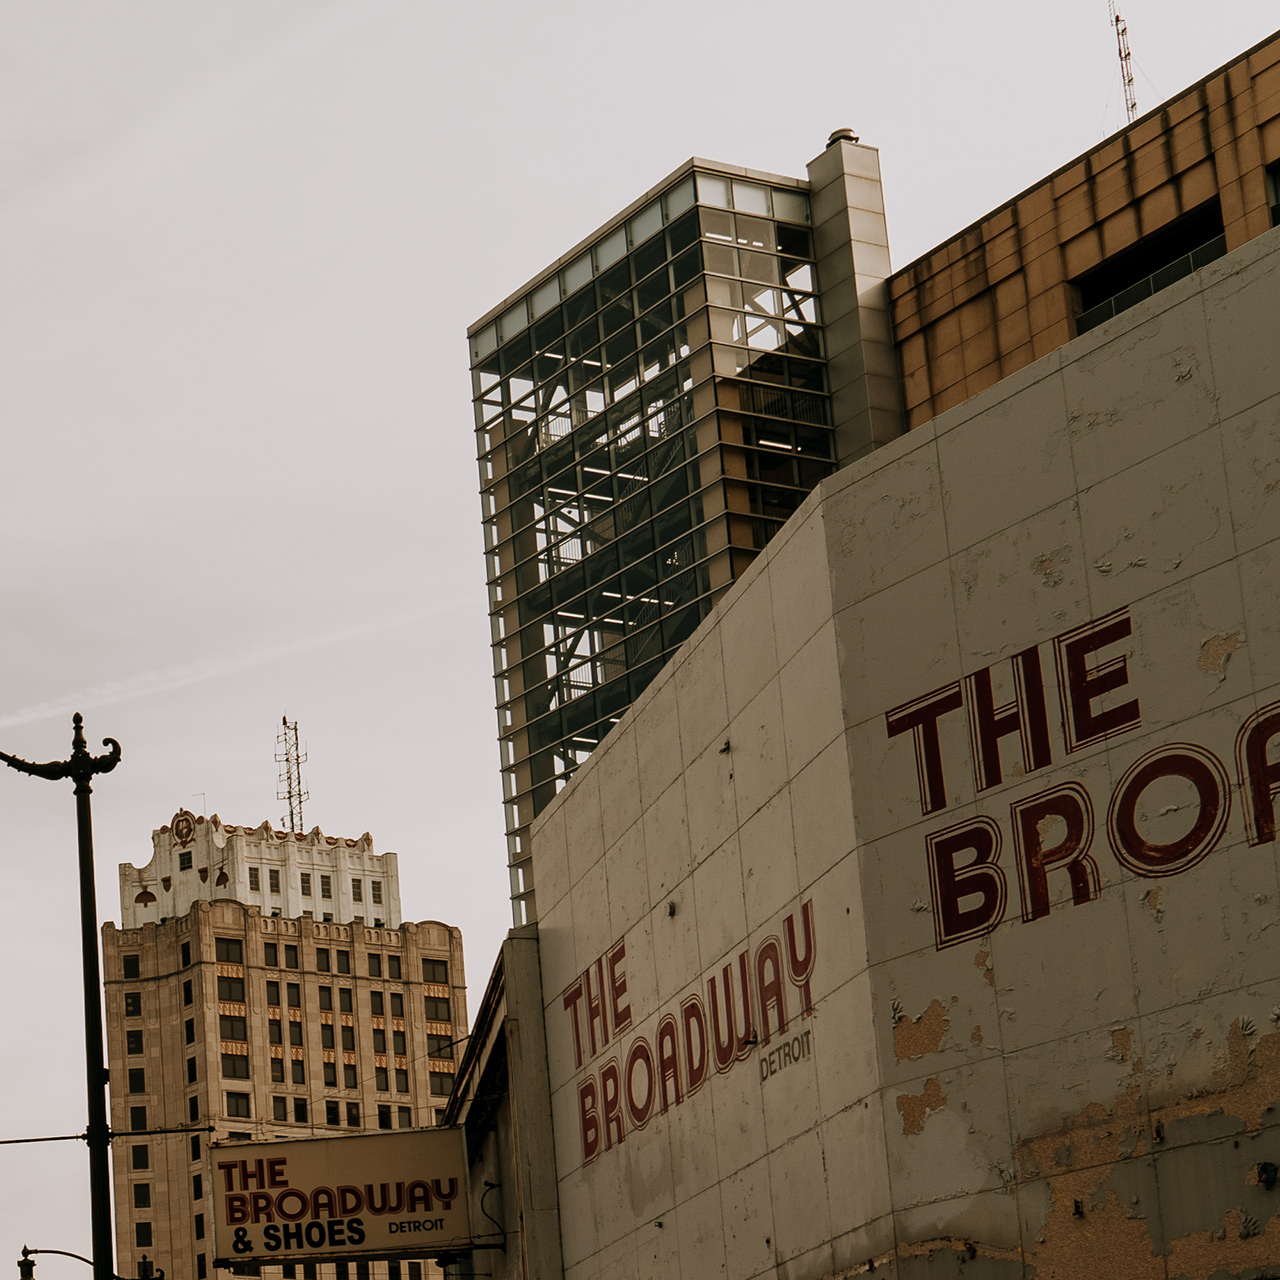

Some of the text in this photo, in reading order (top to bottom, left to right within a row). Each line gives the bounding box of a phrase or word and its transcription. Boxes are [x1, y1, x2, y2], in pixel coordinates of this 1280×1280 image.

[885, 605, 1143, 817] THE
[561, 934, 633, 1070] THE
[576, 897, 817, 1169] BROADWAY
[759, 1029, 812, 1083] DETROIT
[217, 1156, 290, 1192] THE
[224, 1176, 459, 1227] BROADWAY
[231, 1217, 446, 1255] & SHOES DETROIT
